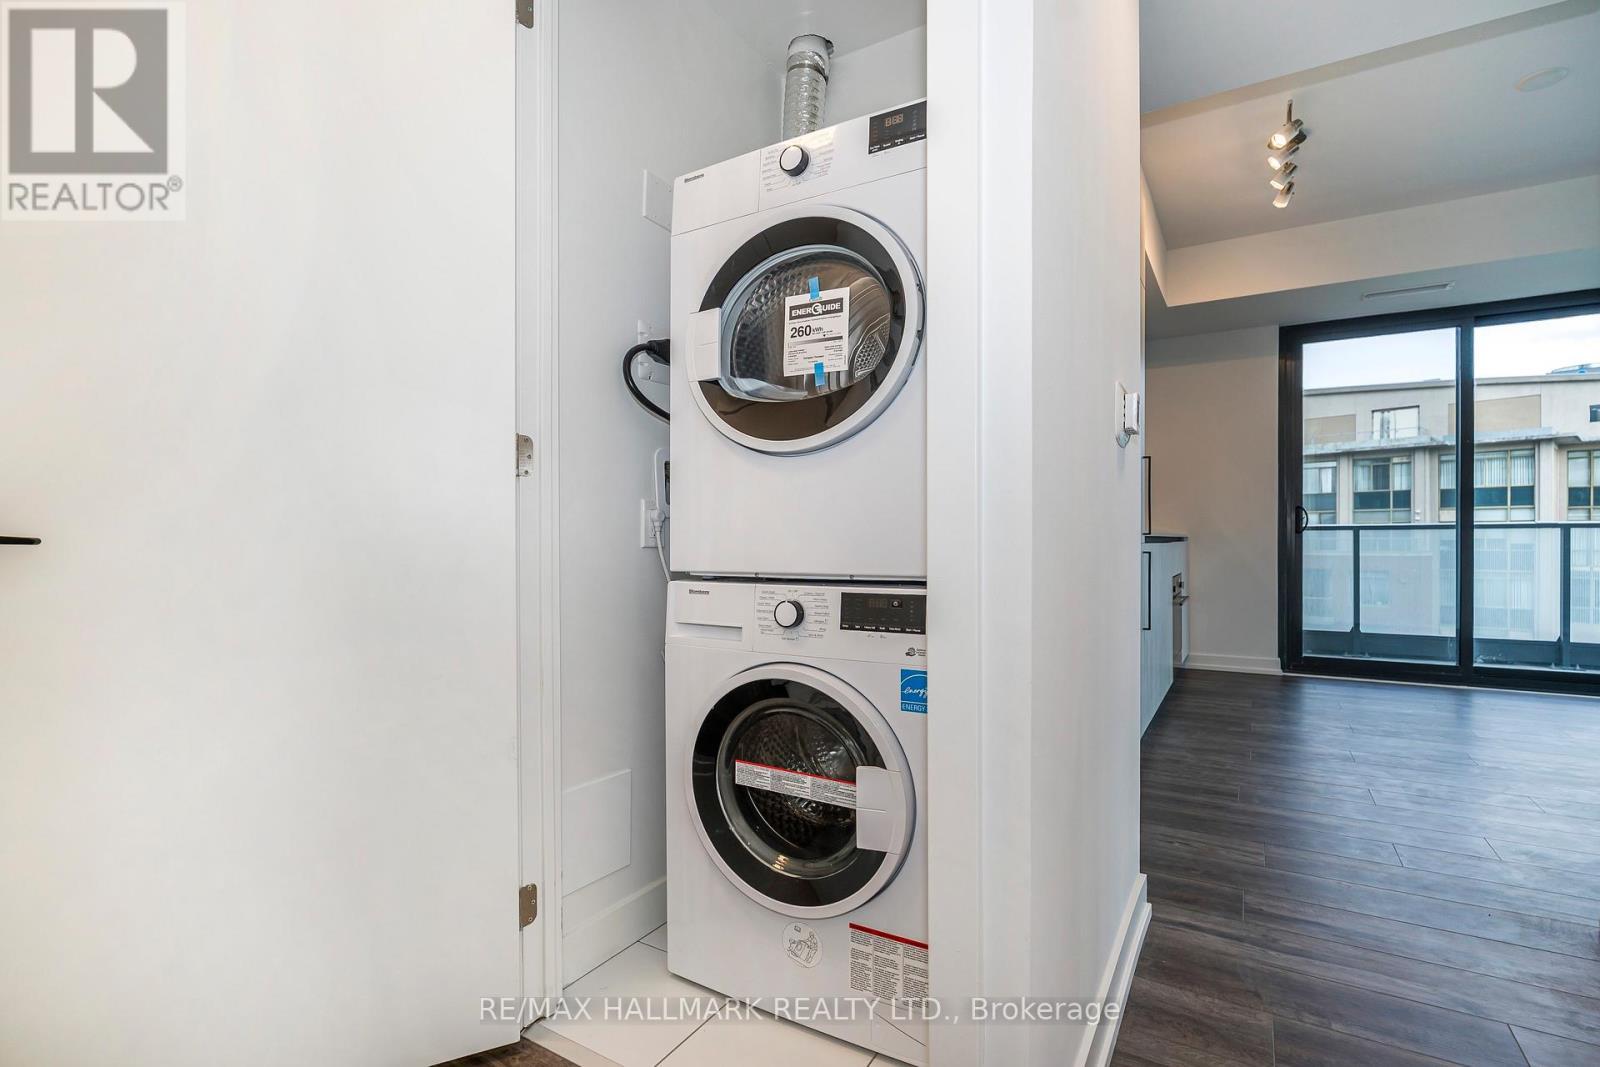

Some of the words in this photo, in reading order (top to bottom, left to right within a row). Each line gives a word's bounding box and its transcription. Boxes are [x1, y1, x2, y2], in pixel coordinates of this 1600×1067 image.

[793, 303, 841, 317] ENERGUIDE
[790, 325, 811, 338] 260
[902, 703, 926, 711] ENERGY
